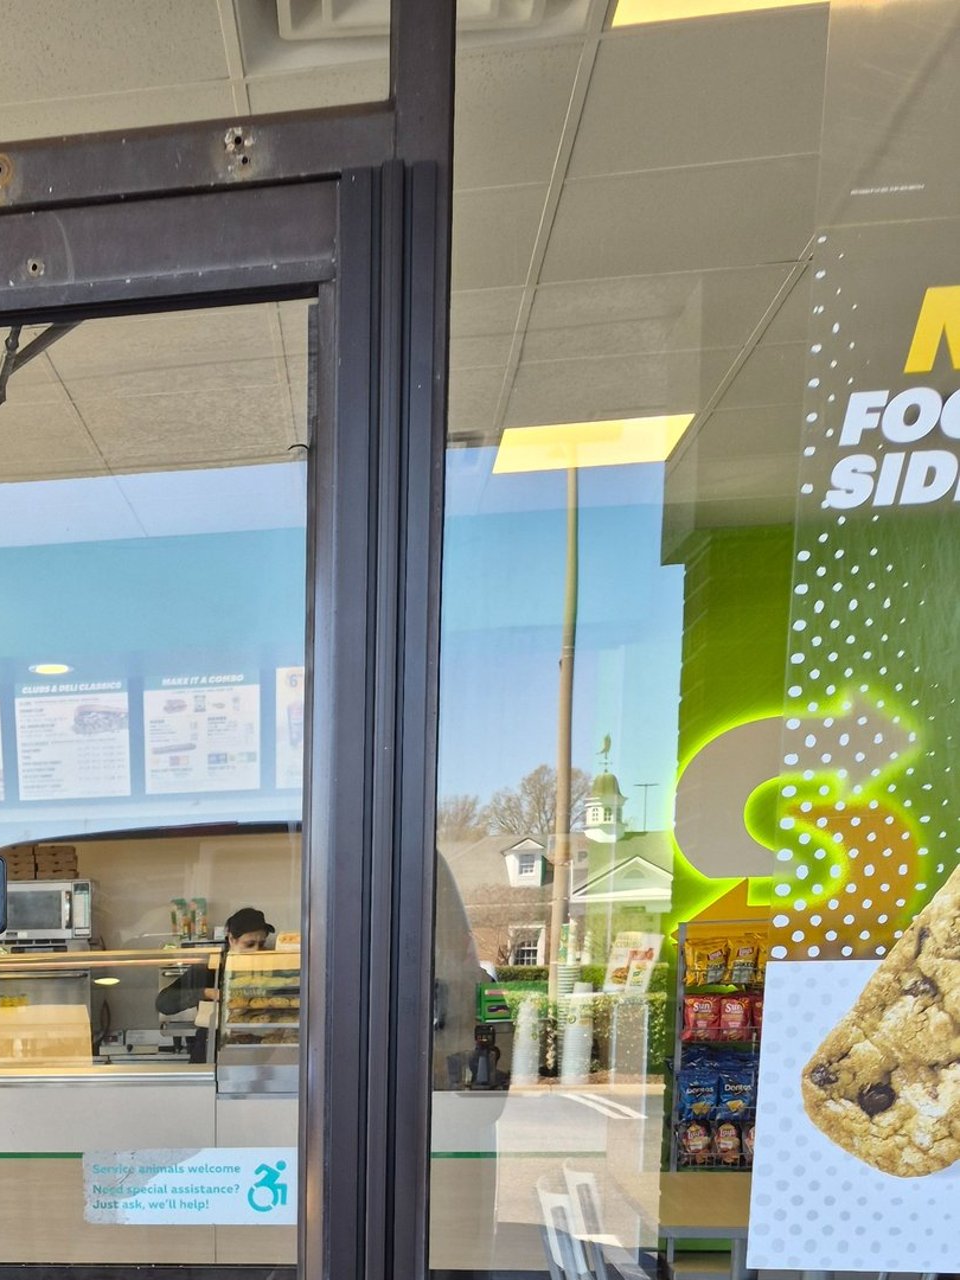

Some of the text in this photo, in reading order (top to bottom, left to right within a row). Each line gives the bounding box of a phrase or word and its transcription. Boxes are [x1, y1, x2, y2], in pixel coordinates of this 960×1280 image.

[826, 450, 960, 509] SID
[92, 1163, 240, 1174] Service animals welcome
[92, 1184, 240, 1196] Need special assistance?
[92, 1200, 119, 1210] Just
[122, 1199, 145, 1211] ask,
[179, 1199, 209, 1211] help!
